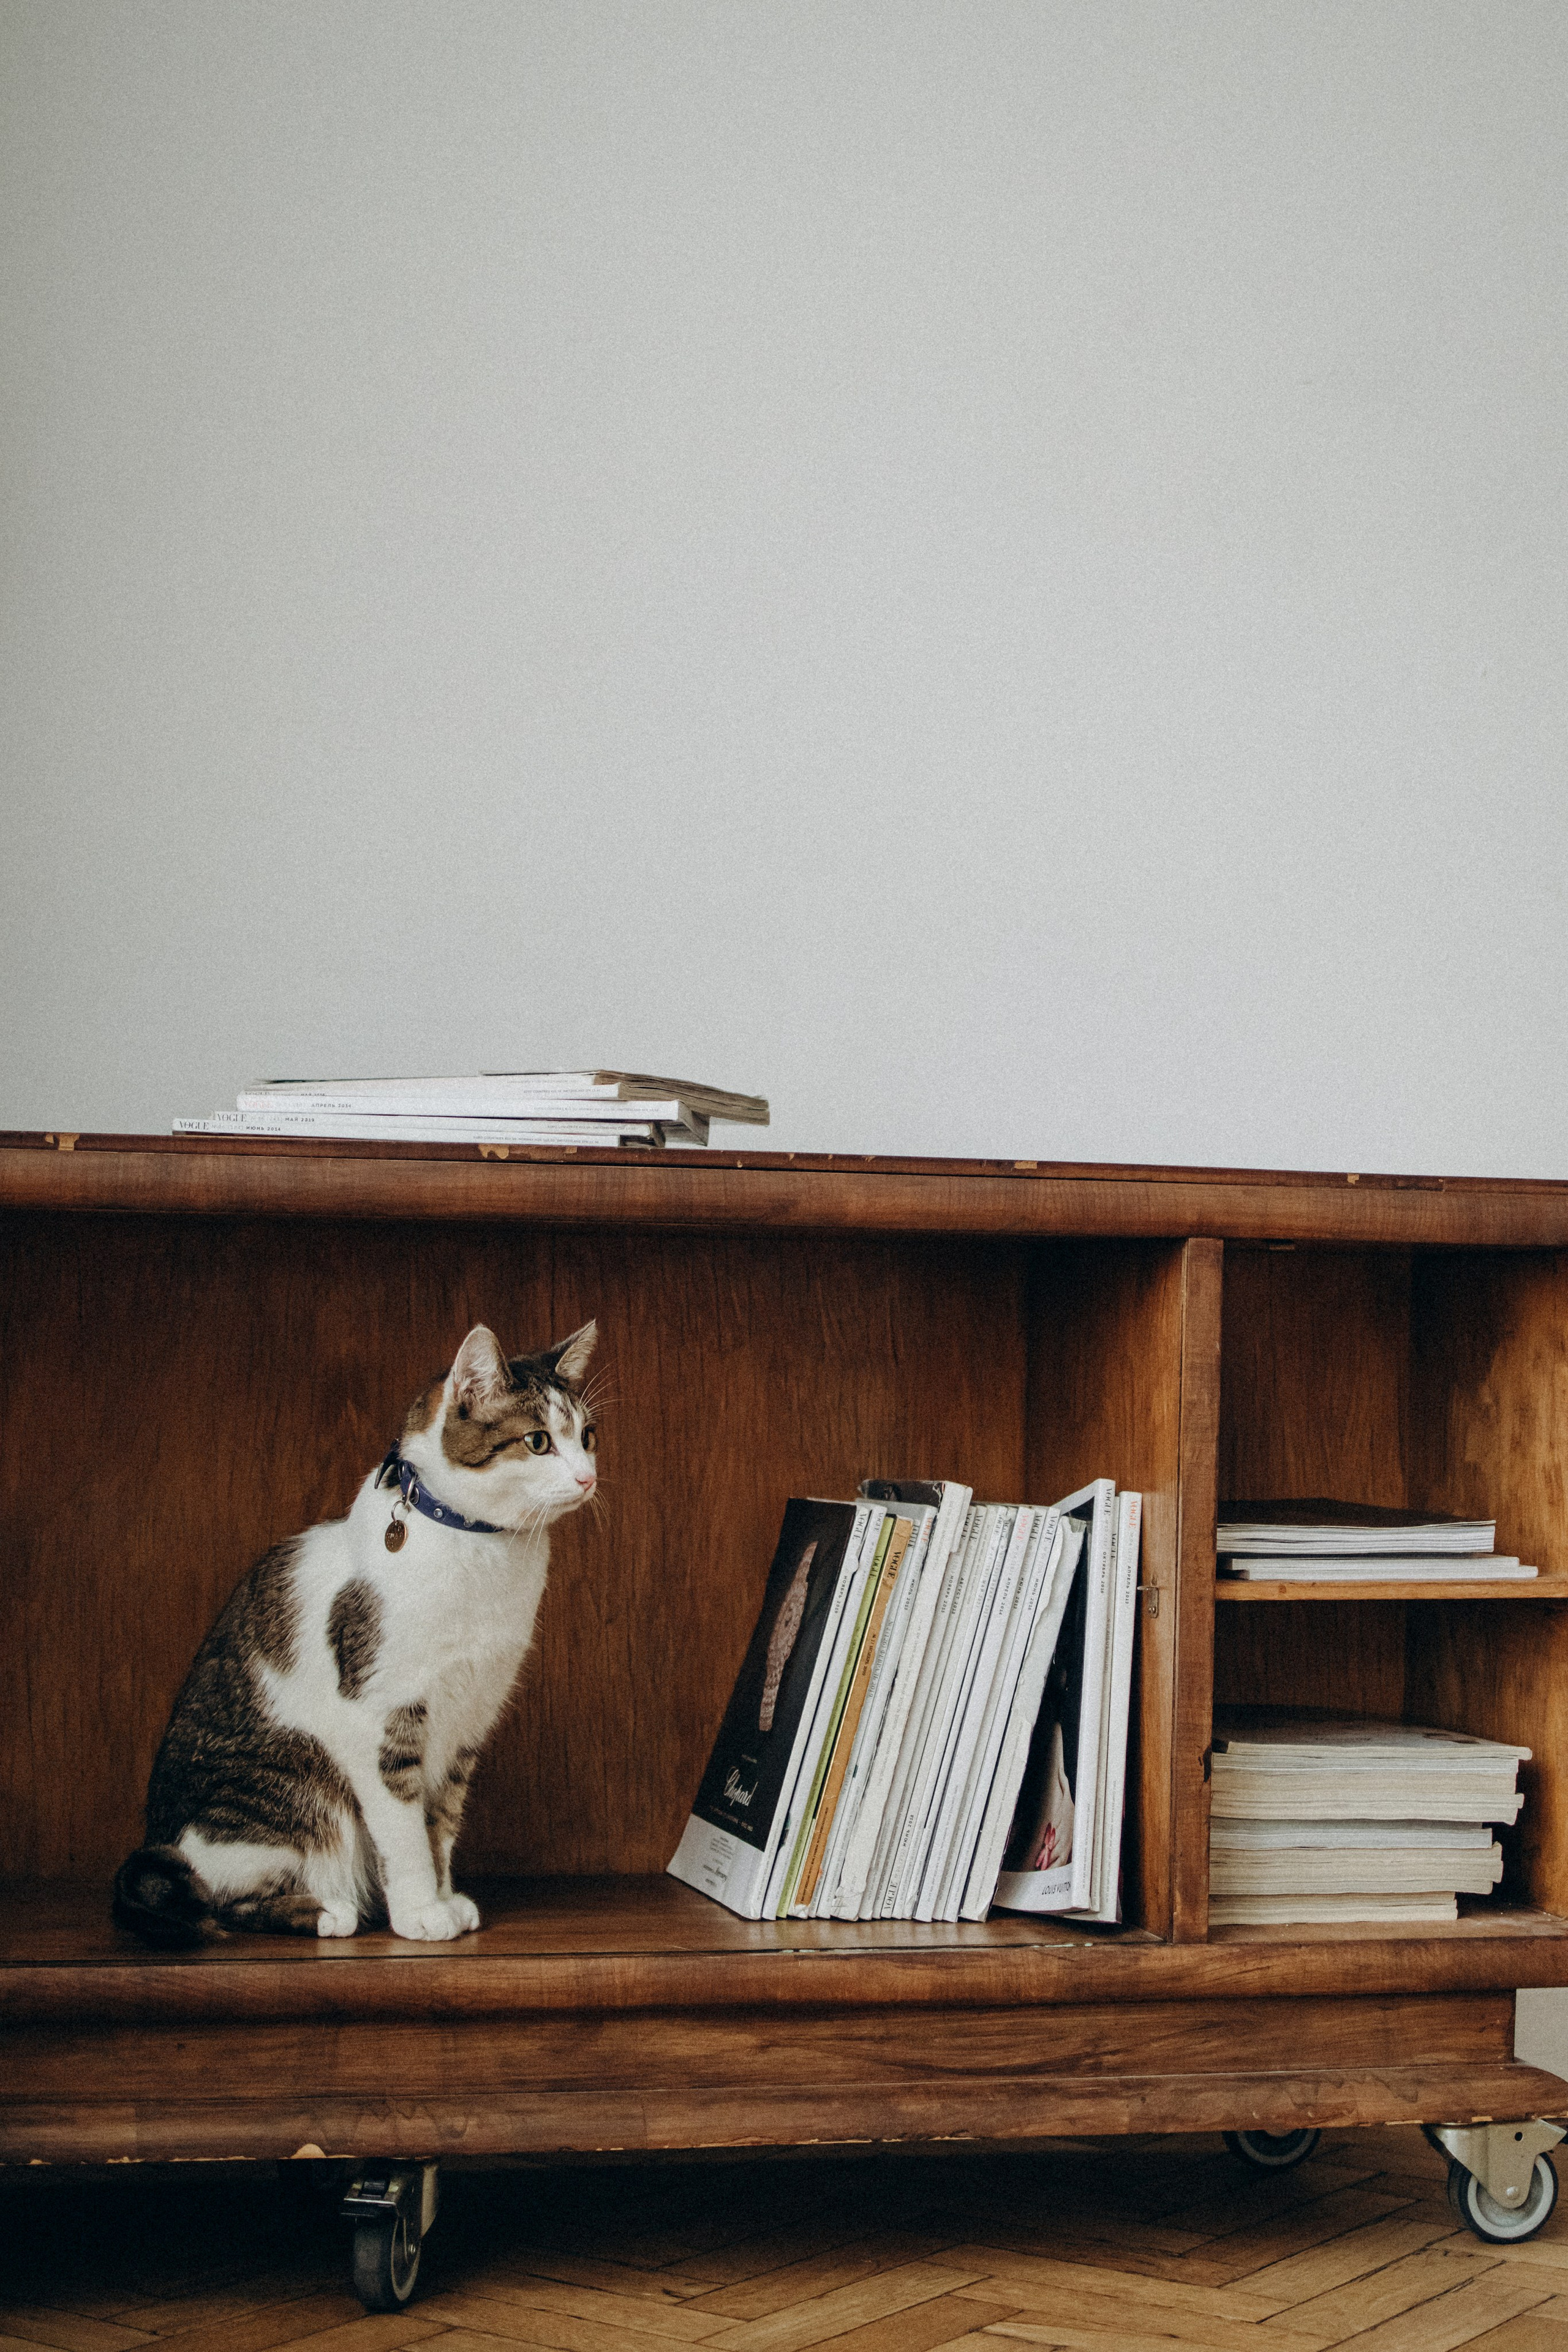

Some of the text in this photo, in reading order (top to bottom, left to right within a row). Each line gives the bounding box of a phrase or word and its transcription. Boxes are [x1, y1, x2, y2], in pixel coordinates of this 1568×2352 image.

[178, 1120, 209, 1130] VOGUE
[216, 1114, 246, 1122] VOGUE
[1103, 1488, 1112, 1516] VOGUE
[1128, 1500, 1137, 1529] VOGUE
[852, 1512, 866, 1541] VOGUE
[873, 1511, 883, 1532] VOGUE
[921, 1517, 932, 1542] VOGUE
[968, 1514, 982, 1543] VOGUE
[1015, 1513, 1028, 1541] VOGUE
[1028, 1513, 1042, 1542] VOGUE
[1043, 1514, 1058, 1544] VOGUE
[868, 1554, 882, 1580] VOGUE
[886, 1550, 901, 1579] VOGUE
[838, 1575, 848, 1599] НОЯБРЬ
[944, 1575, 954, 1599] НОЯБРЬ
[954, 1577, 964, 1600] АВГУСТ
[986, 1578, 996, 1602] ЯНВАРЬ
[1001, 1577, 1011, 1600] АПРЕЛЬ
[1031, 1578, 1039, 1596] ИЮНЬ
[864, 1645, 873, 1665] НОЯБРЬ
[872, 1649, 886, 1681] ФЕВРАЛЬ
[723, 1766, 758, 1806] Chopard
[883, 1880, 898, 1911] VOGUE
[1042, 1885, 1057, 1895] LOUIS
